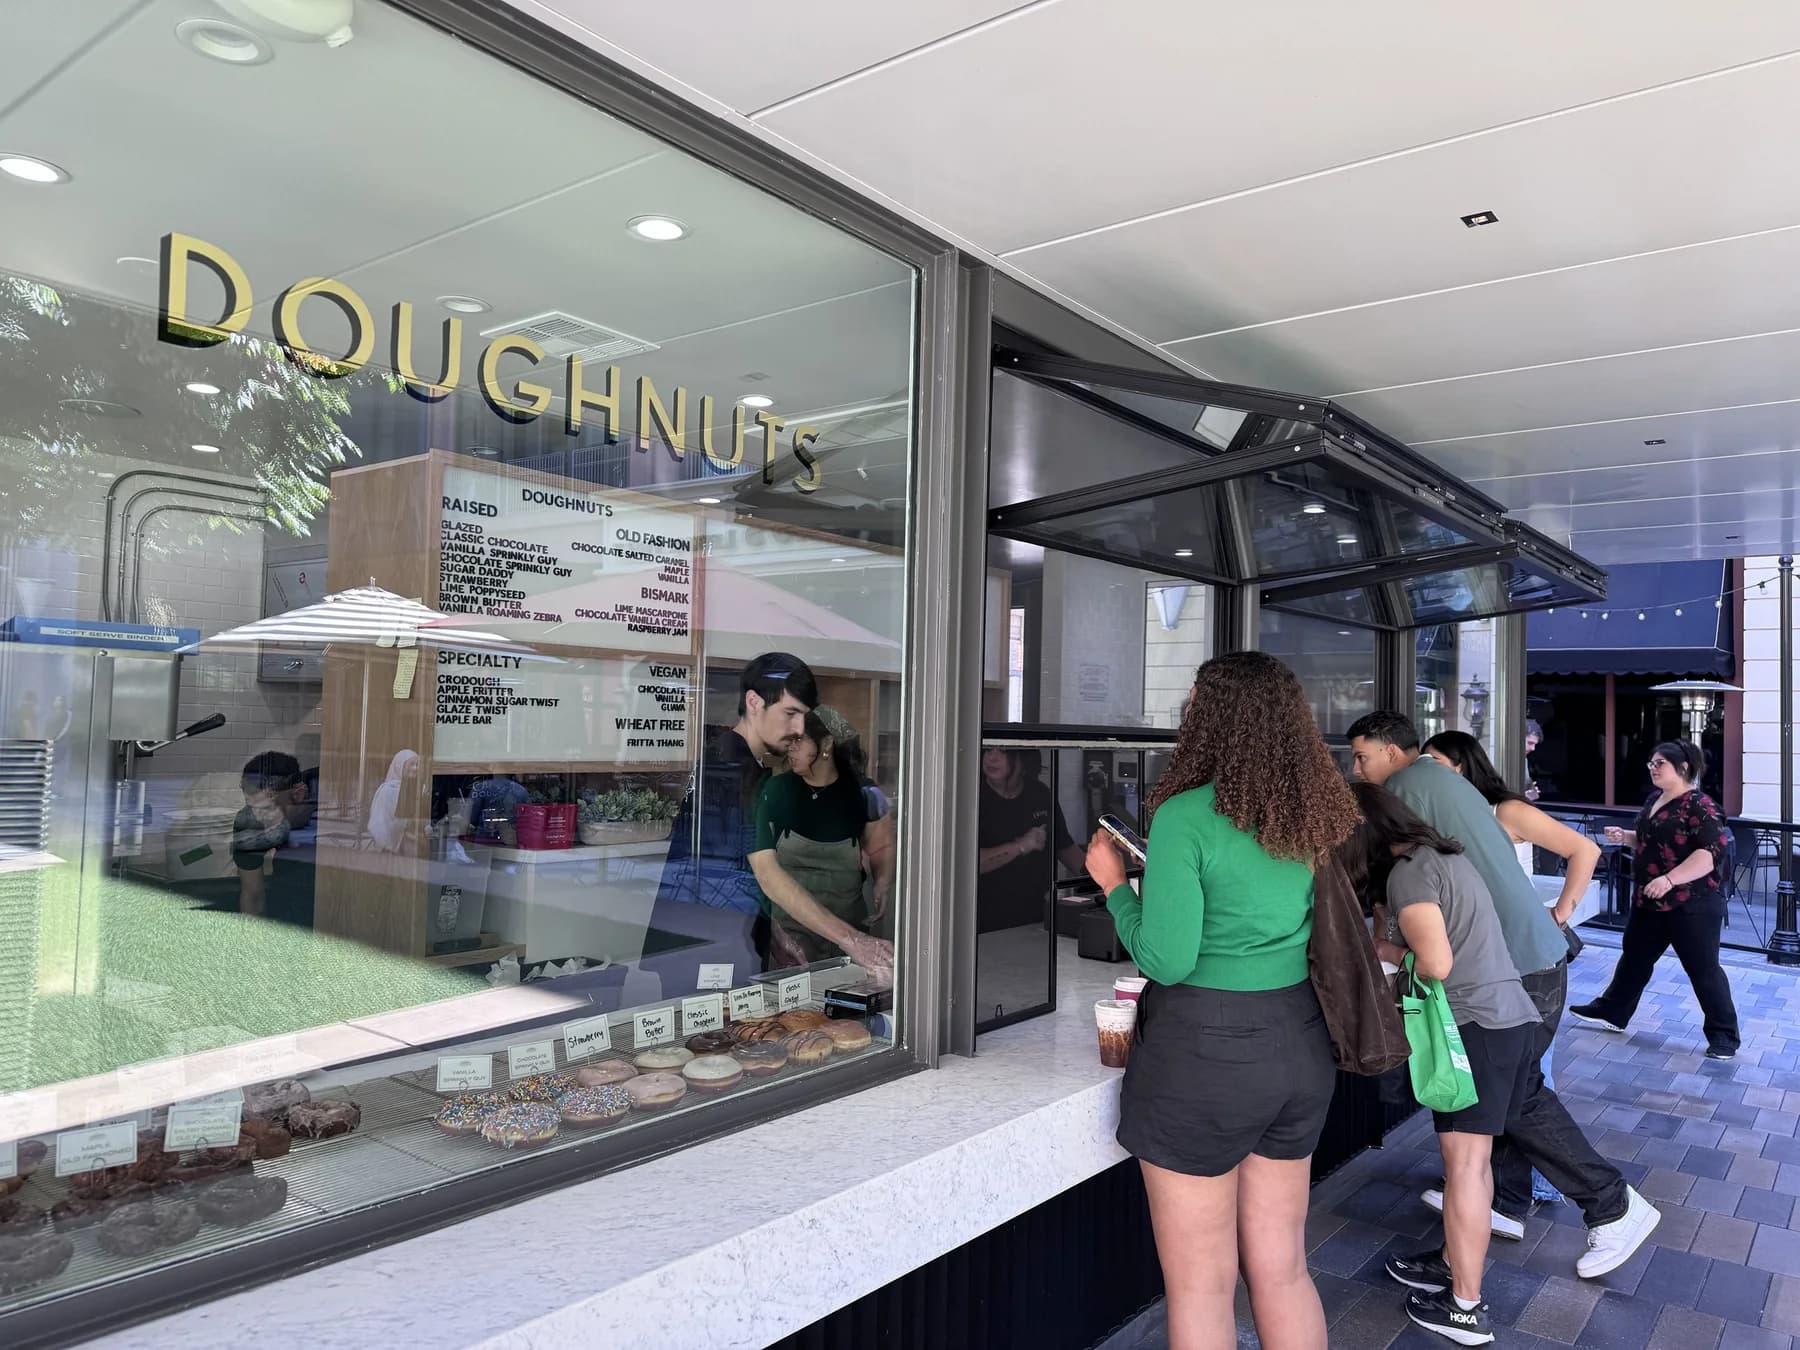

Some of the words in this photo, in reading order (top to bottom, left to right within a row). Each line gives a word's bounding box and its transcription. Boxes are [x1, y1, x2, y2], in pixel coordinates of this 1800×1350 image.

[158, 231, 821, 493] DOUGHNUTS
[442, 496, 498, 518] RAISED
[522, 489, 613, 517] DOUGHNUTS
[441, 520, 483, 534] GLAZED
[441, 531, 484, 545] CLASSIC
[488, 537, 548, 554] CHOCOLATE
[616, 528, 641, 543] OLD
[643, 533, 690, 552] FASHION
[440, 542, 485, 555] VANILLA
[490, 549, 535, 562] SPRINKLY
[537, 555, 558, 565] GUY
[571, 542, 623, 558] CHOCOLATE
[625, 550, 654, 562] SALTED
[656, 555, 690, 568] CARAMEL
[440, 552, 502, 568] CHOCOLATE
[505, 561, 551, 575] SPRINKLY
[553, 568, 573, 577] GUY
[440, 562, 475, 575] SUGAR
[478, 567, 514, 579] DADDY
[664, 566, 690, 576] MAPLE
[440, 573, 508, 588] STRAWBERRY
[658, 573, 690, 584] VANILLA
[439, 583, 464, 593] LIME
[469, 585, 526, 600] POPPYSEED
[641, 587, 689, 604] BISMARK
[439, 593, 478, 605] BROWN
[482, 598, 522, 609] BUTTER
[439, 602, 483, 614] VANILLA
[486, 607, 531, 619] ROAMING
[533, 612, 562, 623] ZEBRA
[575, 608, 626, 622] CHOCOLATE
[628, 614, 660, 626] VANILLA
[661, 618, 688, 628] CREAM
[615, 604, 633, 613] LIME
[636, 606, 688, 620] MASCARPONE
[628, 624, 671, 636] RASPBERRY
[672, 628, 688, 637] JAM
[438, 651, 522, 669] SPECIALTY
[437, 675, 500, 686] CRODOUGH
[649, 666, 686, 679] VEGAN
[437, 685, 470, 694] APPLE
[472, 686, 514, 696] FRITTER
[638, 685, 686, 695] CHOCOLATE
[437, 694, 493, 705] CINNAMON
[496, 697, 528, 706] SUGAR
[529, 698, 560, 707] TWIST
[655, 694, 686, 703] VANILLA
[437, 705, 472, 714] GLAZE
[475, 706, 508, 715] TWIST
[436, 715, 470, 724] MAPLE
[472, 716, 492, 724] BAR
[615, 718, 658, 731] WHEAT
[660, 719, 686, 731] FREE
[627, 738, 654, 747] FRITTA
[656, 739, 685, 747] THANG
[568, 1028, 605, 1049] Strawberry
[1450, 1312, 1478, 1325] HOKA
